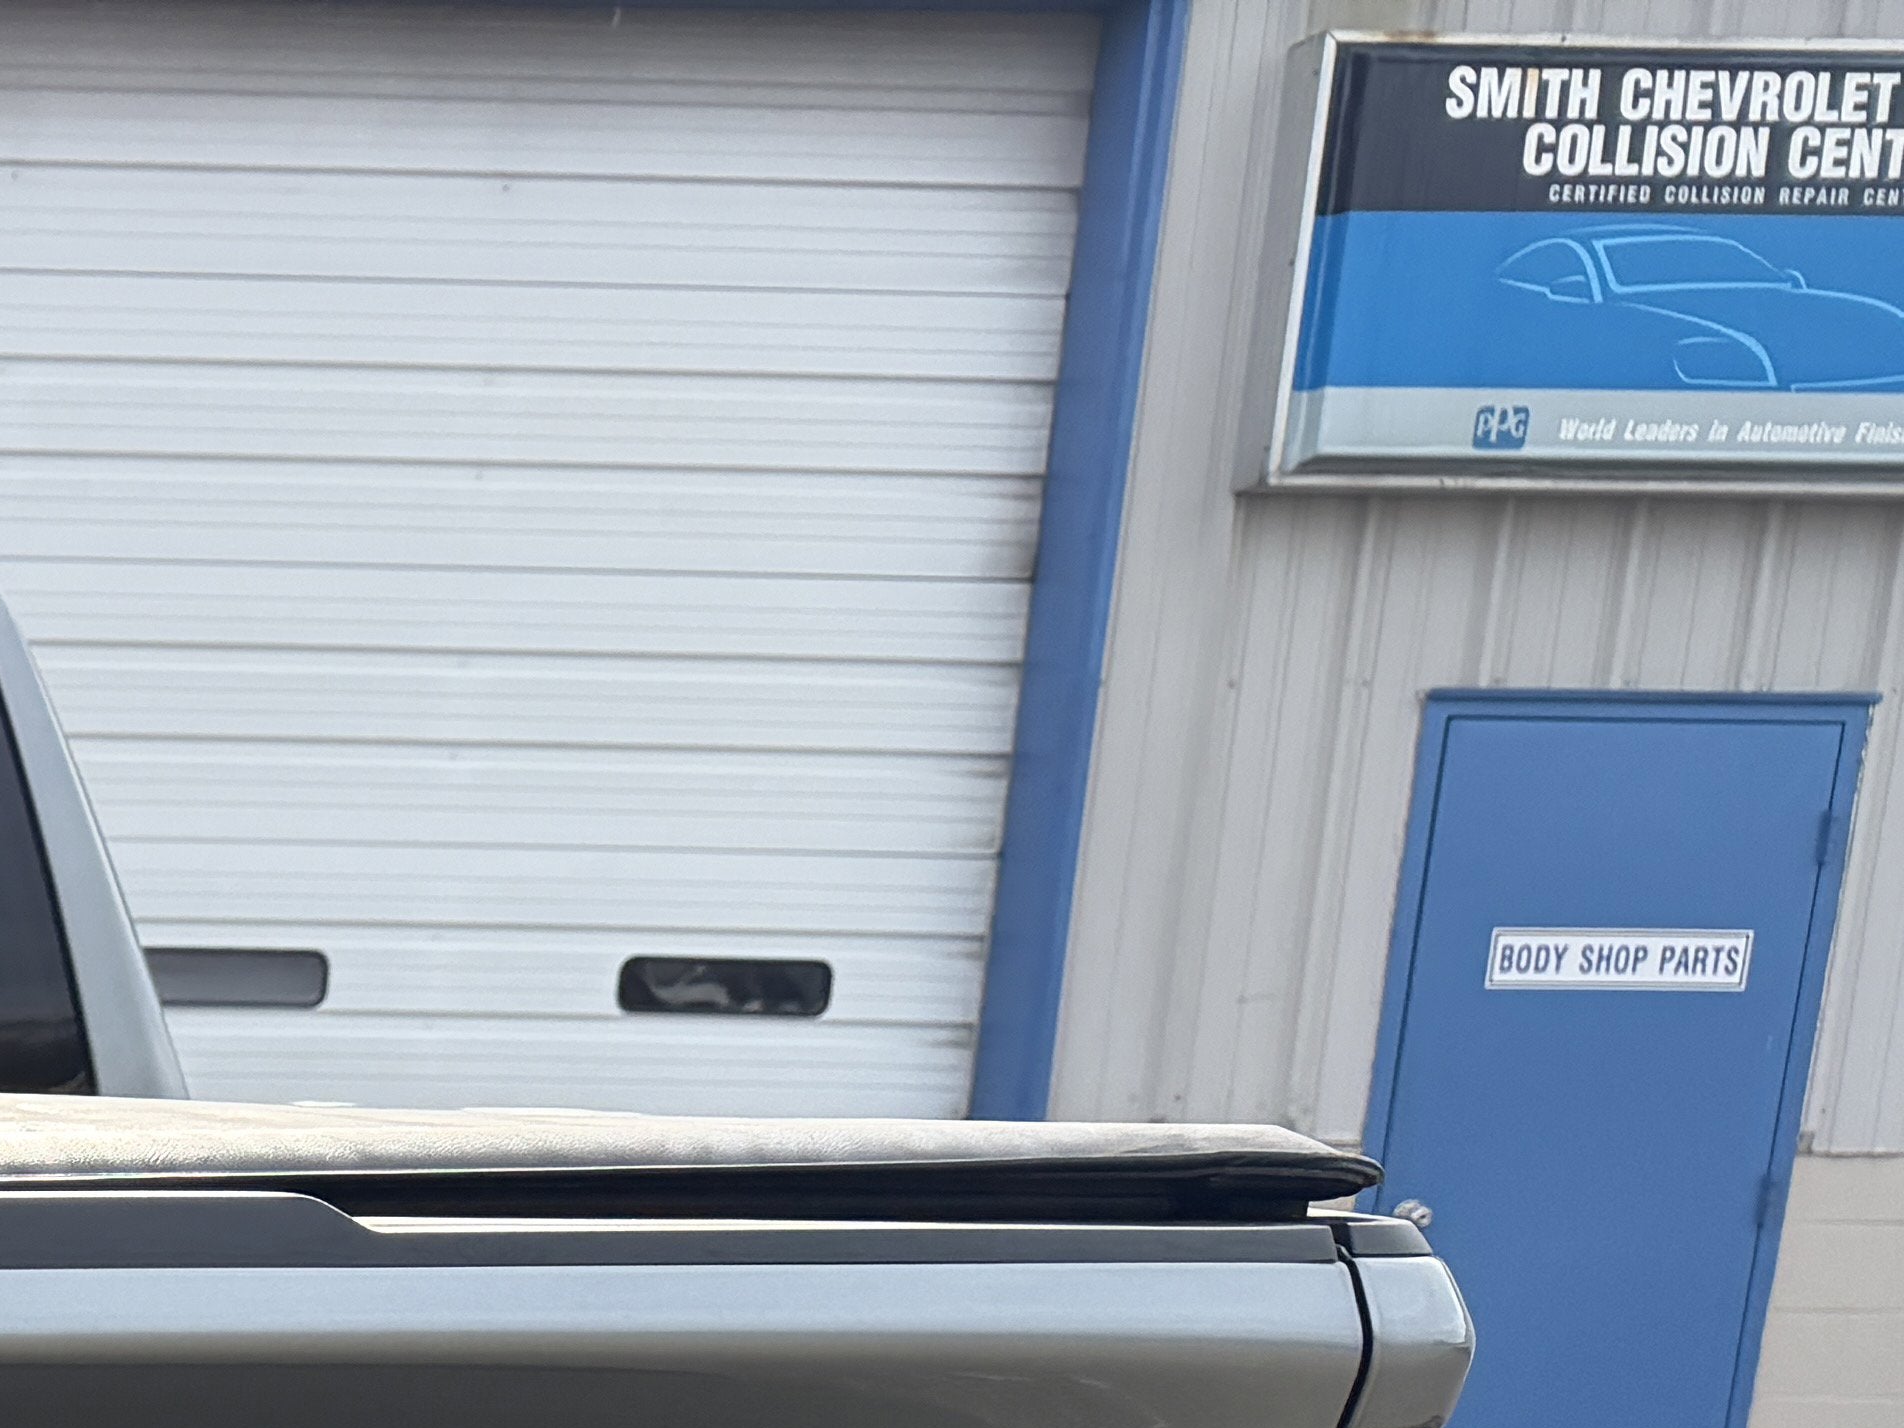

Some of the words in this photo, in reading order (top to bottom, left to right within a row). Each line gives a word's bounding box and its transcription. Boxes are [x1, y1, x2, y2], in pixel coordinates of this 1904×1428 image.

[1445, 65, 1602, 119] SMITH
[1619, 67, 1901, 123] CHEVROLET
[1522, 122, 1770, 177] COLLISION
[1548, 183, 1651, 203] CERTIFIED
[1664, 185, 1766, 205] COLLISION
[1778, 186, 1849, 206] REPAIR
[1863, 187, 1904, 206] CEN
[1475, 404, 1529, 443] PPG
[1559, 417, 1616, 441] World
[1623, 418, 1700, 442] Leaders
[1707, 419, 1729, 442] in
[1737, 420, 1847, 444] Automotive
[1855, 421, 1904, 444] Finis
[1499, 943, 1569, 975] BODY
[1579, 944, 1648, 975] SHOP
[1658, 945, 1740, 976] PARTS
